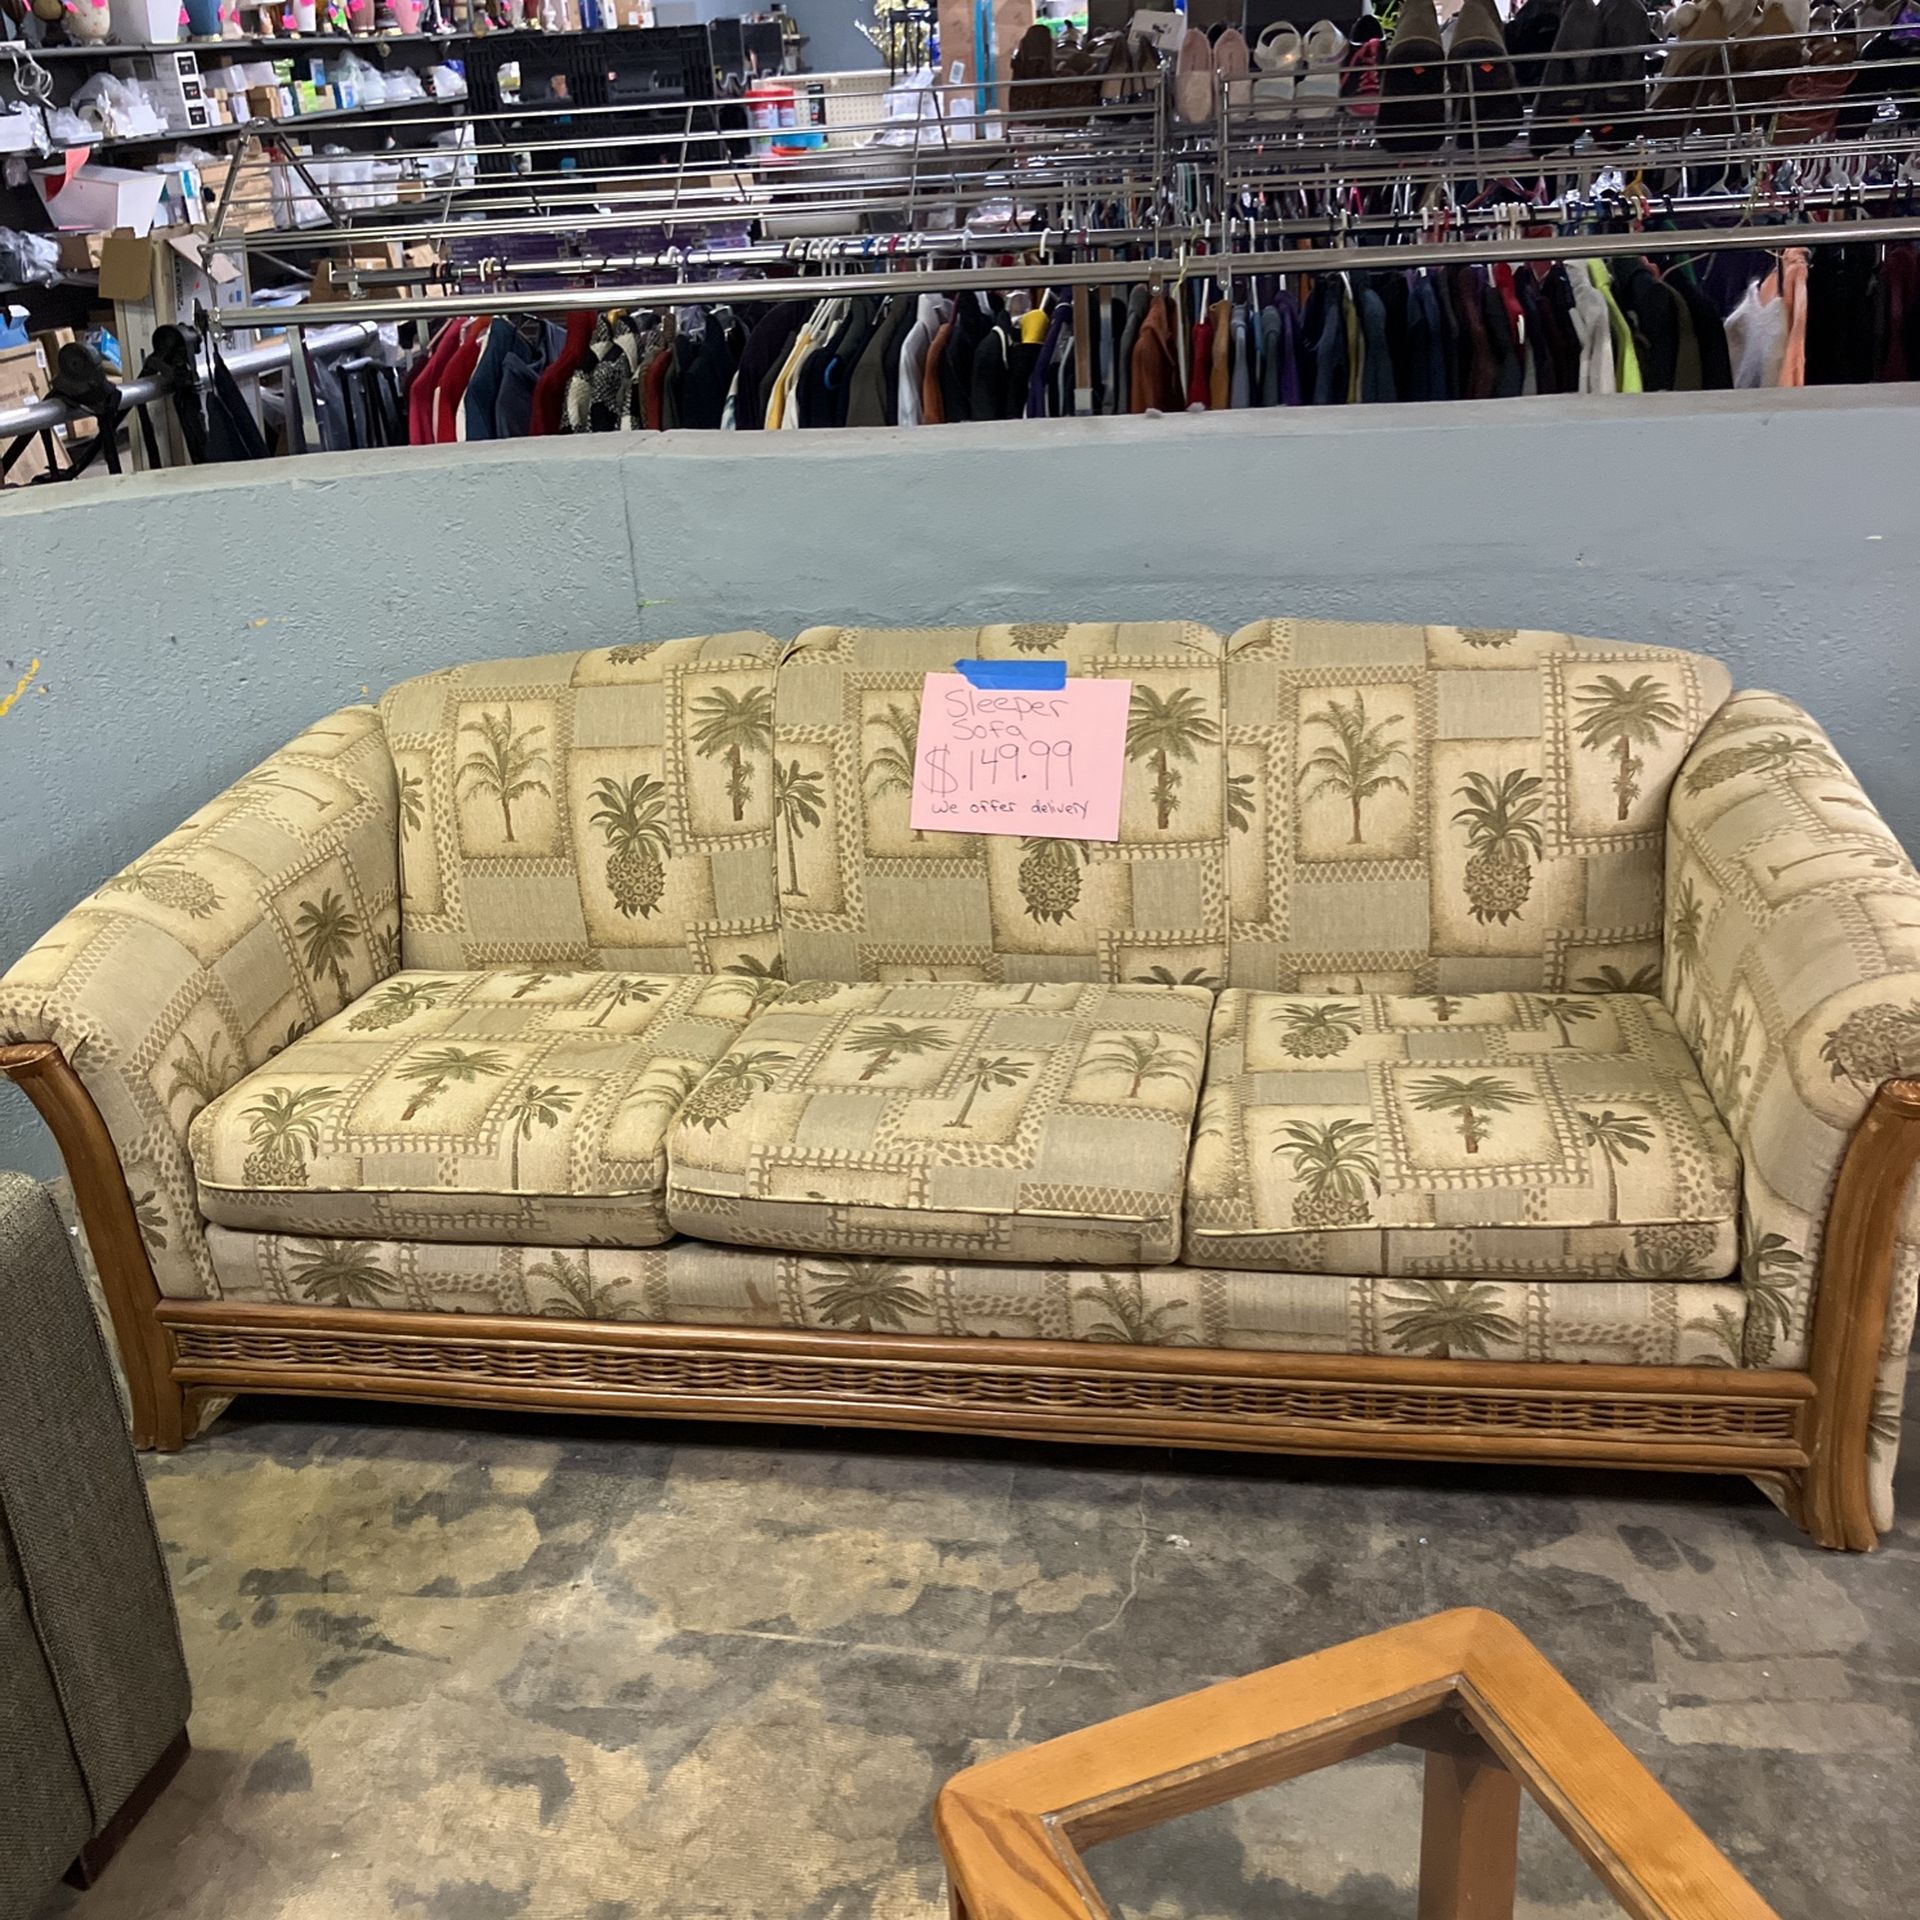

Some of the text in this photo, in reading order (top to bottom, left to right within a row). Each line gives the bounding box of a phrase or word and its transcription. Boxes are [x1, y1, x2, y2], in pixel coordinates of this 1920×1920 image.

[945, 689, 1069, 721] Sleeper
[952, 718, 1028, 741] Sofa
[921, 740, 1073, 798] $149.99
[969, 798, 1017, 813] offer
[1031, 799, 1089, 819] delivery
